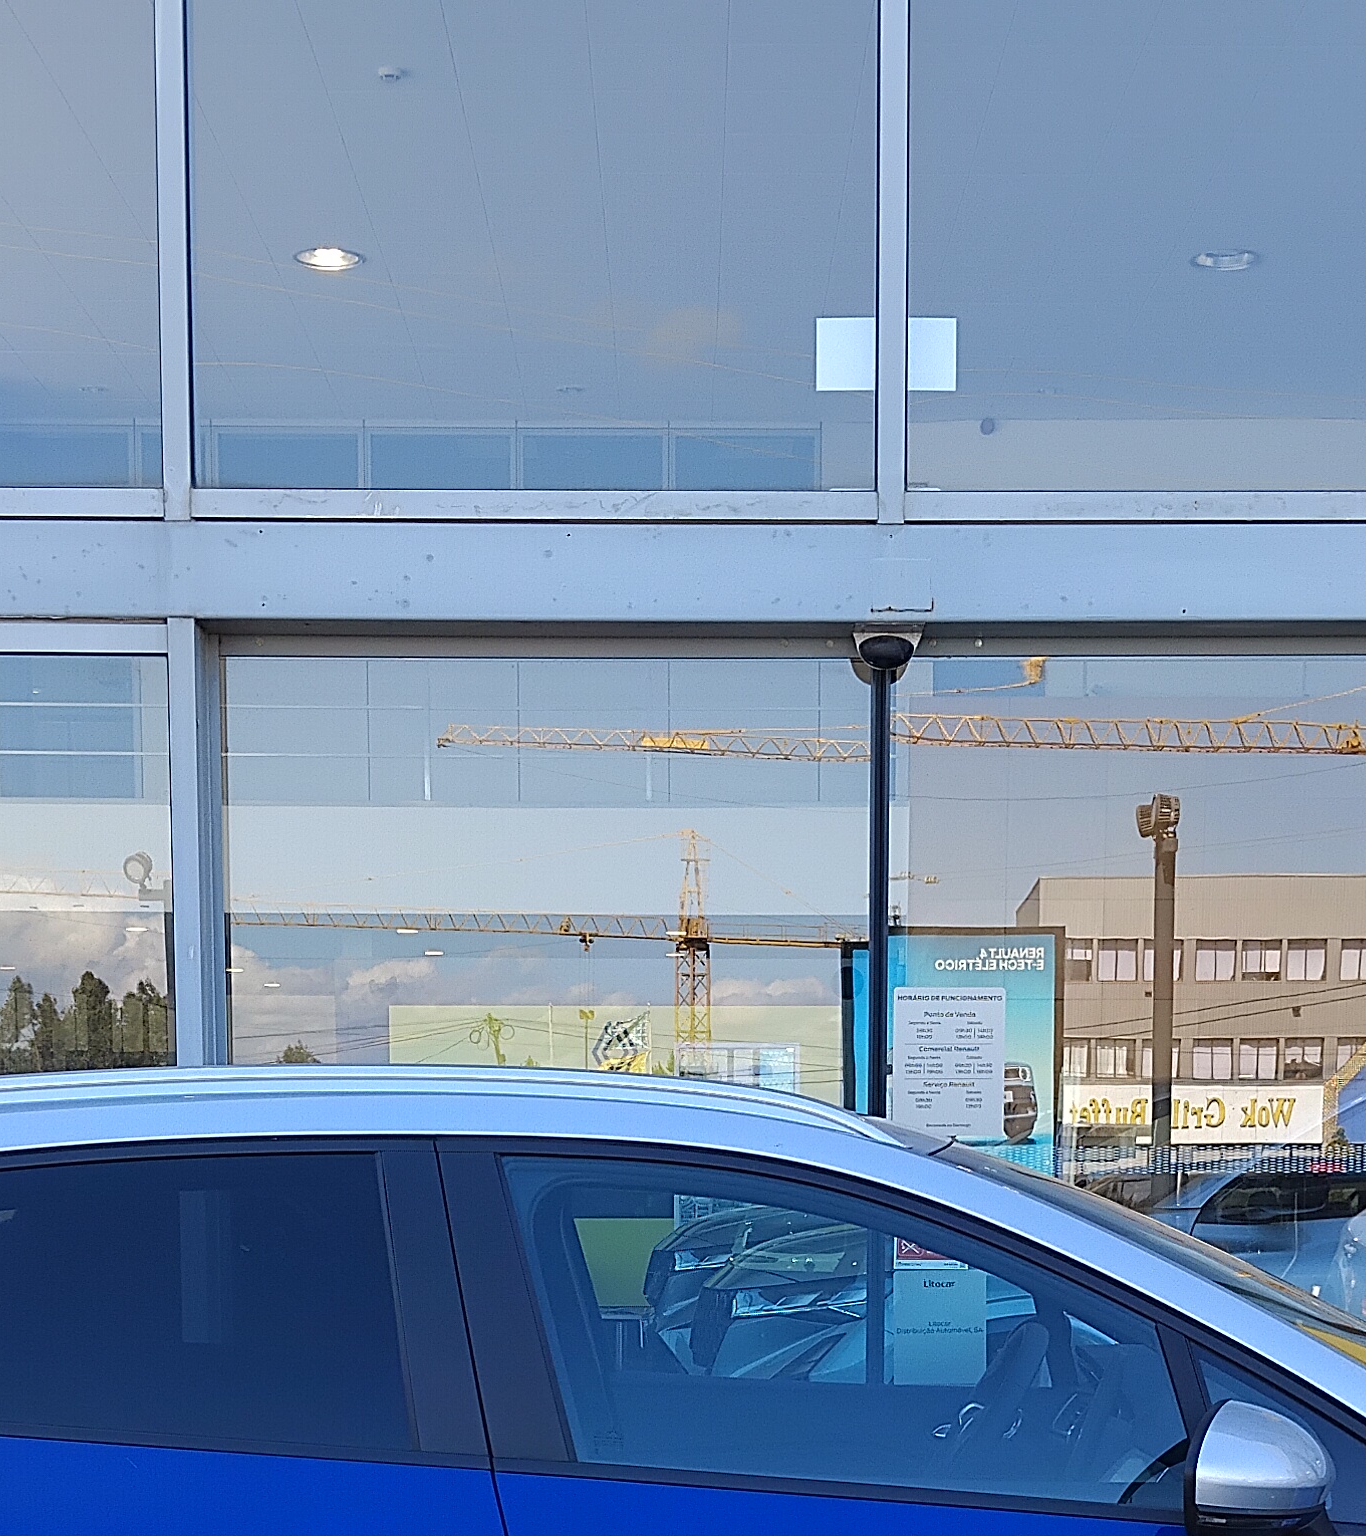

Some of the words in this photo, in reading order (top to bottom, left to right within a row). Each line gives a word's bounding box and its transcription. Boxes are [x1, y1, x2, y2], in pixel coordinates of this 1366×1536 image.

[897, 993, 930, 1001] HORÁRIO
[923, 1279, 956, 1288] Litocar
[896, 1327, 935, 1335] Distribuição
